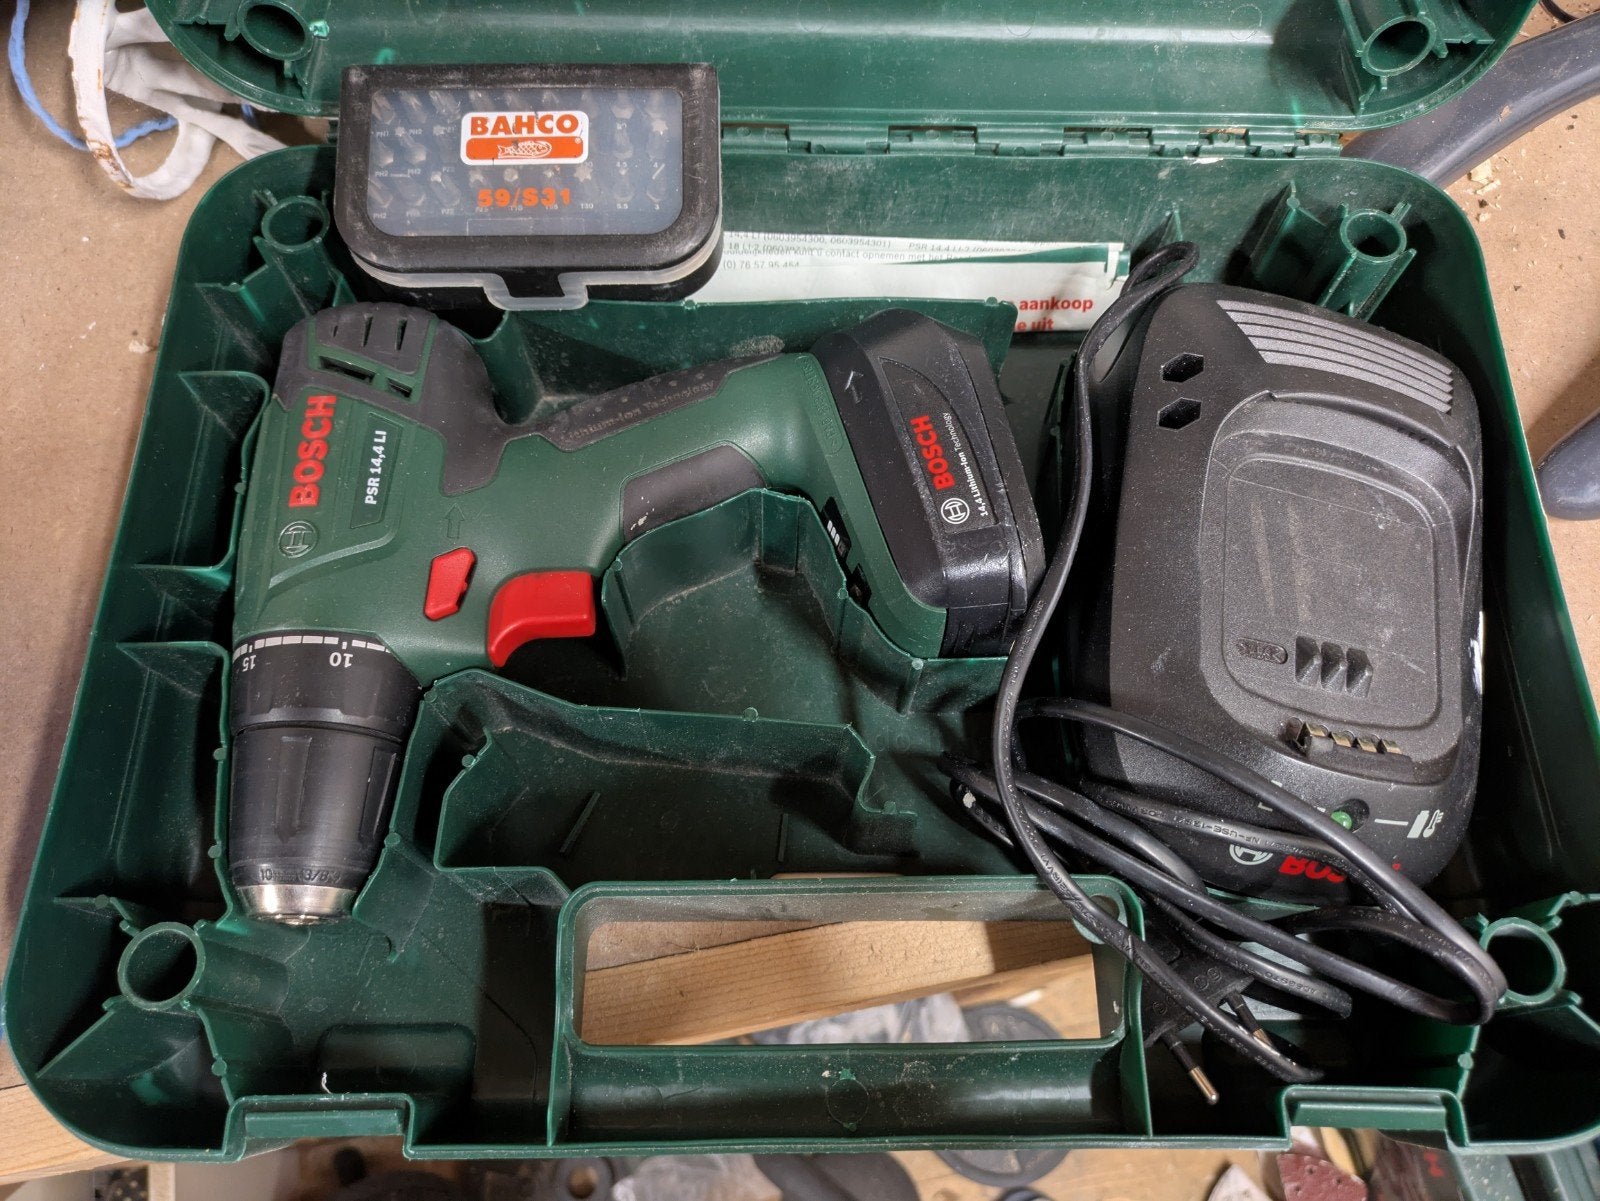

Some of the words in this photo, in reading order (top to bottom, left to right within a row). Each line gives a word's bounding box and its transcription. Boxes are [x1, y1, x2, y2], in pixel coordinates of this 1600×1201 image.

[470, 113, 580, 136] BAHCO
[477, 187, 572, 207] 59/S31
[1019, 296, 1094, 313] aankoop
[943, 412, 961, 453] Technology
[288, 394, 337, 508] BOSCH
[373, 444, 387, 474] 14,4
[910, 415, 955, 491] BOSCH
[365, 477, 382, 505] PSR
[959, 451, 981, 503] Lithium-Ion
[977, 497, 989, 518] 14,4
[242, 654, 257, 672] 15
[329, 651, 354, 668] 10
